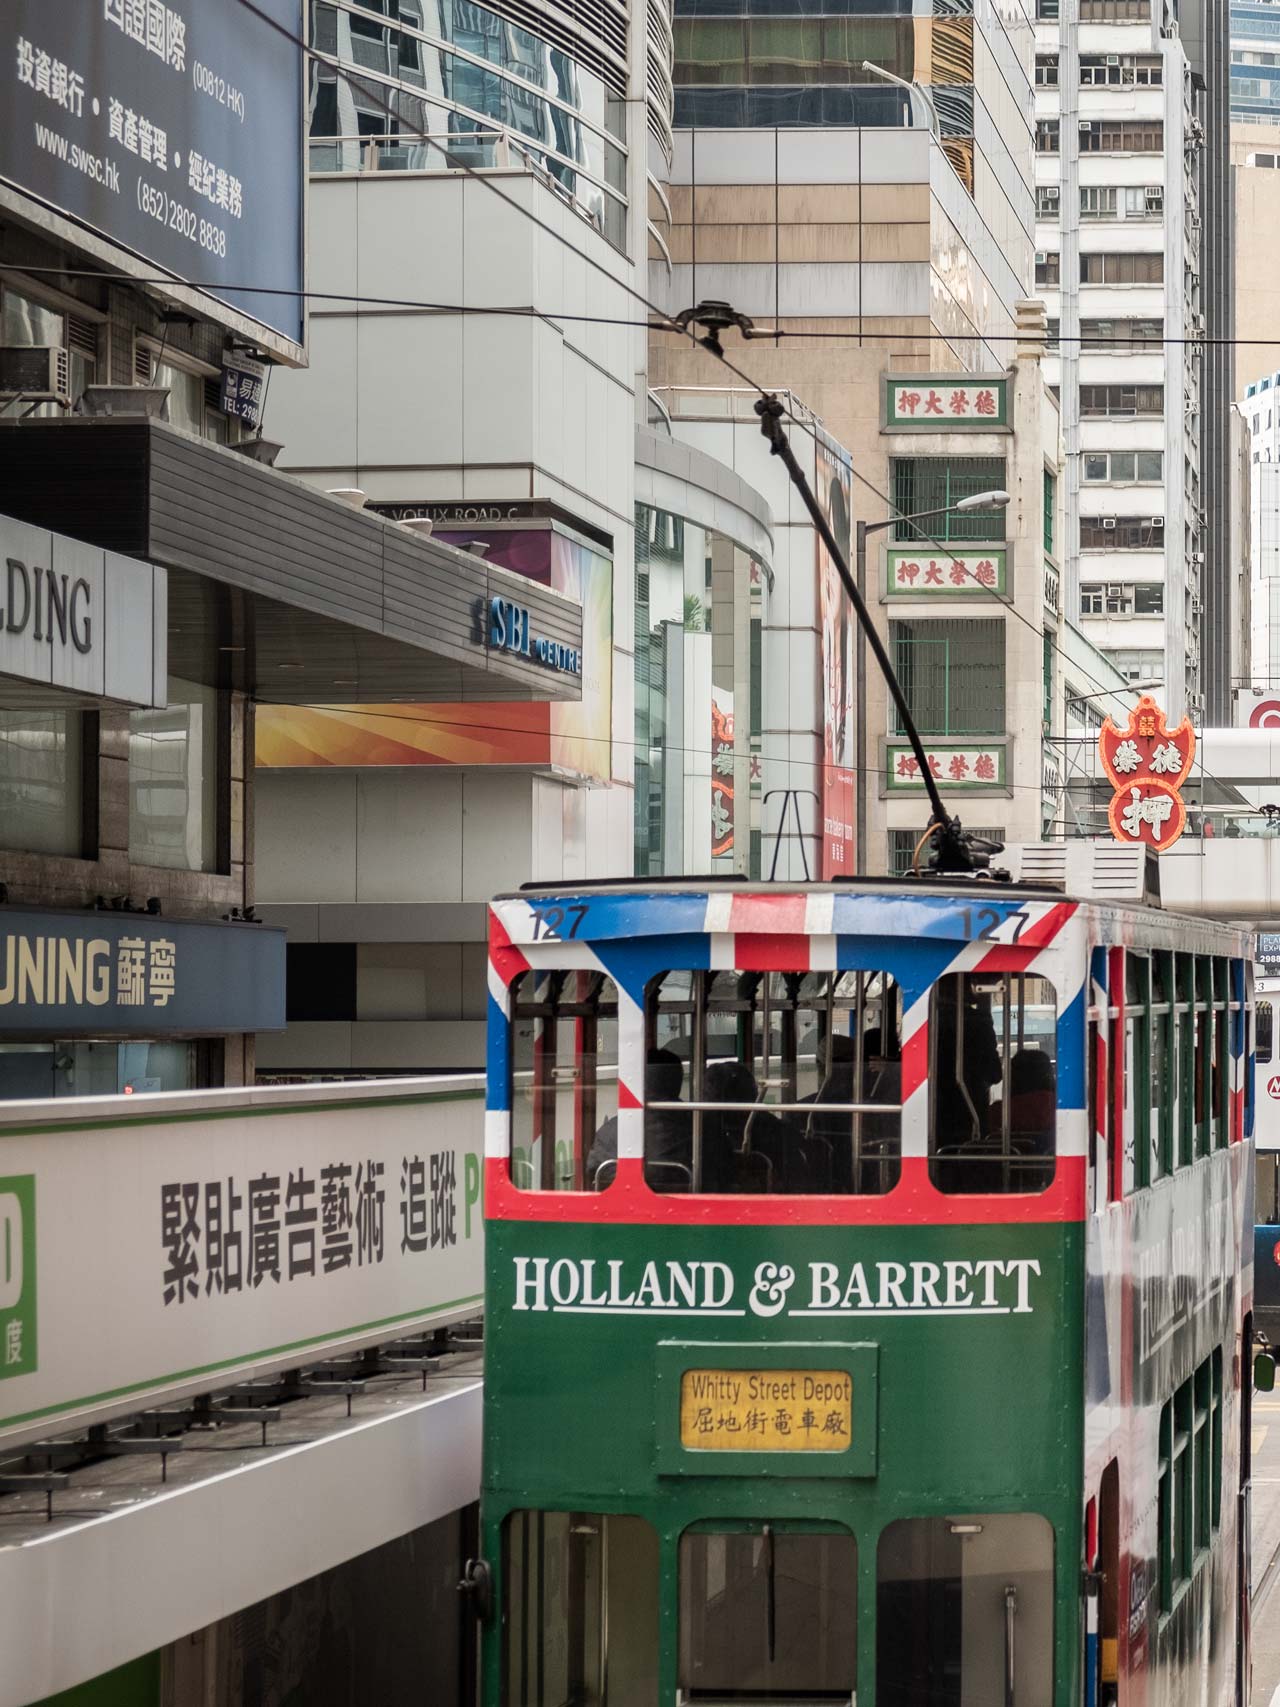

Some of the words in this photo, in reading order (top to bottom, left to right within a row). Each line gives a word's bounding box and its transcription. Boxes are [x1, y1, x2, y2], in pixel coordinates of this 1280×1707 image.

[193, 60, 226, 104] (00812
[227, 90, 245, 122] HK)
[16, 36, 84, 118] 投資銀行
[108, 97, 168, 172] 資產管理
[188, 149, 242, 219] 經紀業務
[35, 122, 120, 194] www.swsc.hk
[200, 222, 226, 258] 8838
[455, 507, 500, 522] ROAD
[0, 557, 92, 655] DING
[491, 596, 530, 657] SBI
[536, 636, 582, 674] CENTRE
[1121, 787, 1172, 842] 押
[528, 905, 589, 941] 127
[957, 908, 1030, 945] 127
[117, 936, 176, 1007] 蘇寧
[1260, 955, 1280, 963] 2988
[512, 1257, 735, 1311] HOLLAND
[748, 1260, 796, 1317] &
[808, 1259, 1042, 1313] BARRETT
[692, 1375, 741, 1404] Whitty
[749, 1375, 796, 1401] Street
[803, 1376, 850, 1405] Depot
[692, 1407, 848, 1437] 屈地街電車廠
